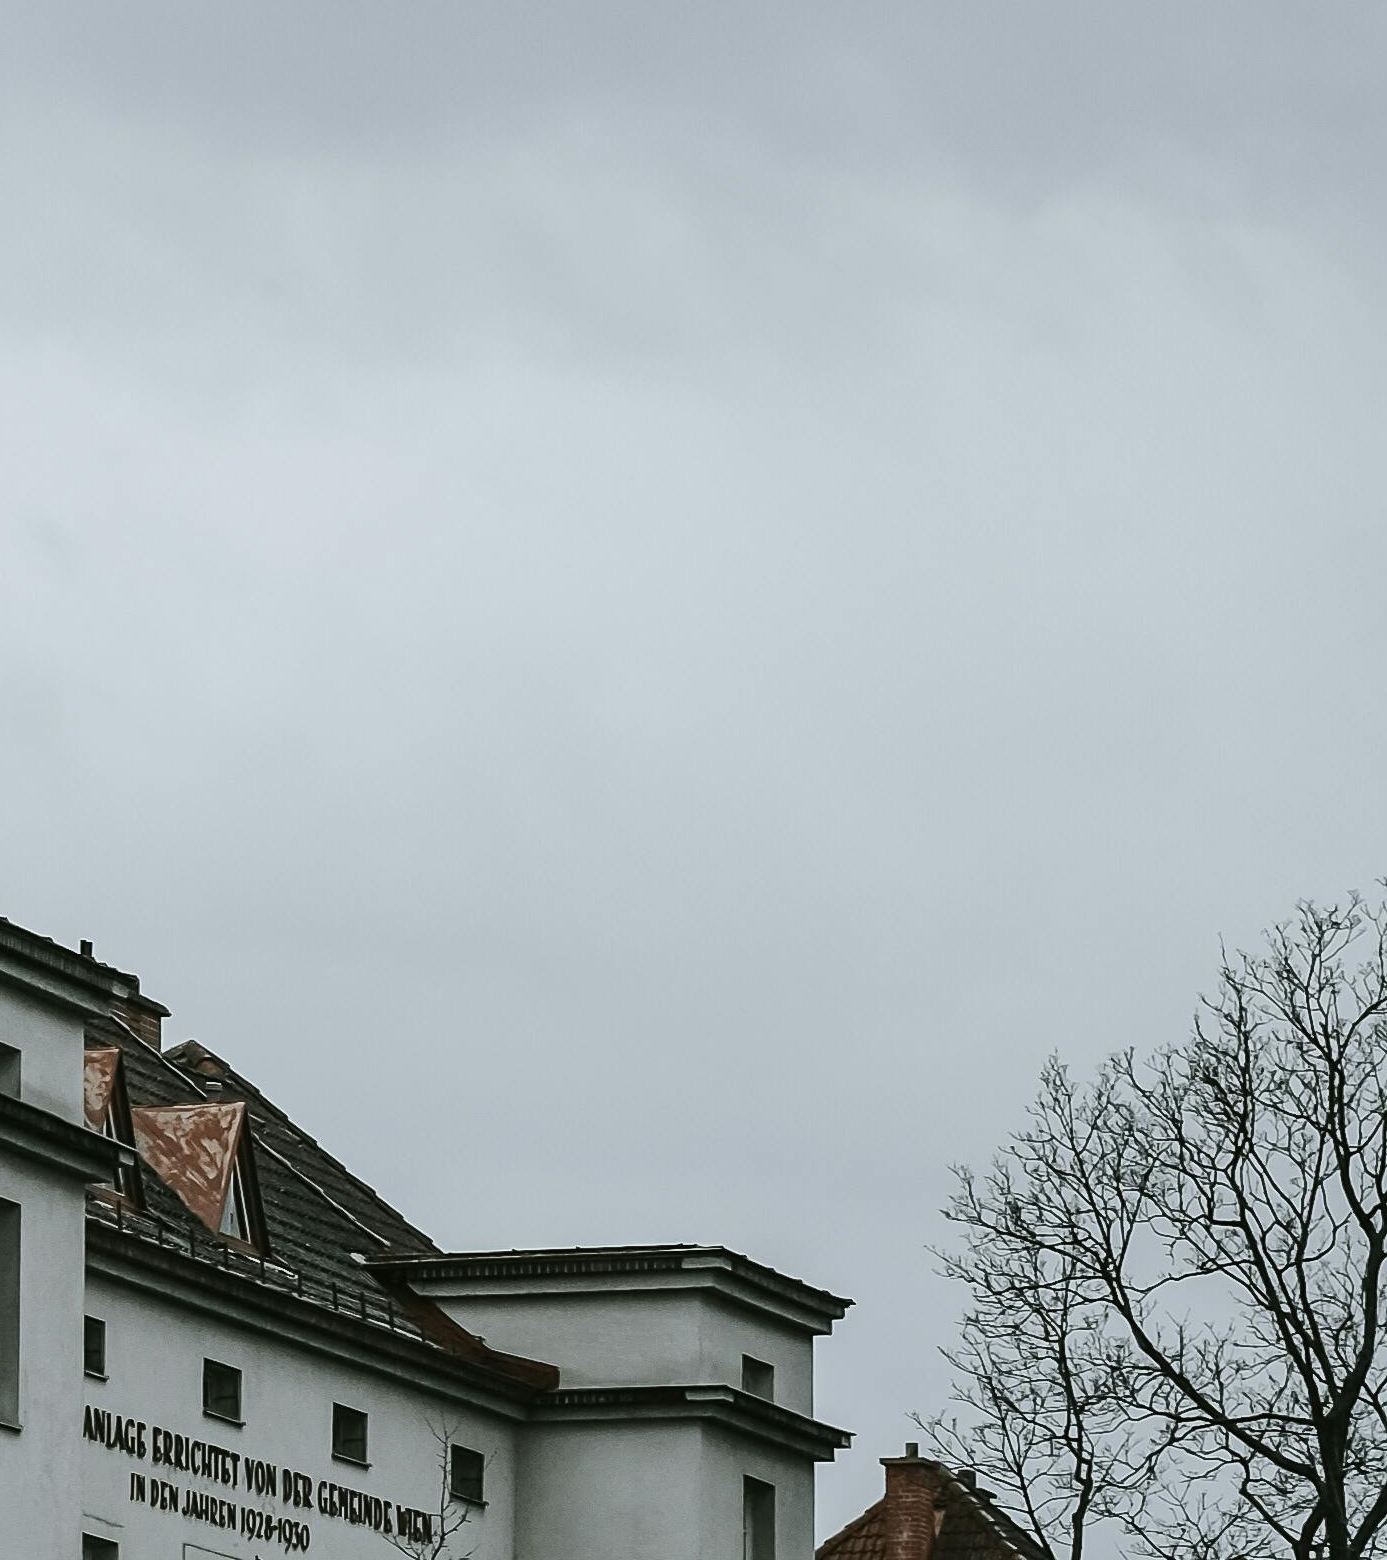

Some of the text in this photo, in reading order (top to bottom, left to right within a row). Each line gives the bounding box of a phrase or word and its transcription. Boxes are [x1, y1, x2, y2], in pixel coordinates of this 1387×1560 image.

[83, 1405, 433, 1545] ANLAGE ERRICHTET VON DER GEMEINDE WIEN
[130, 1472, 311, 1554] IN DEN JAHREN 1928-1930
